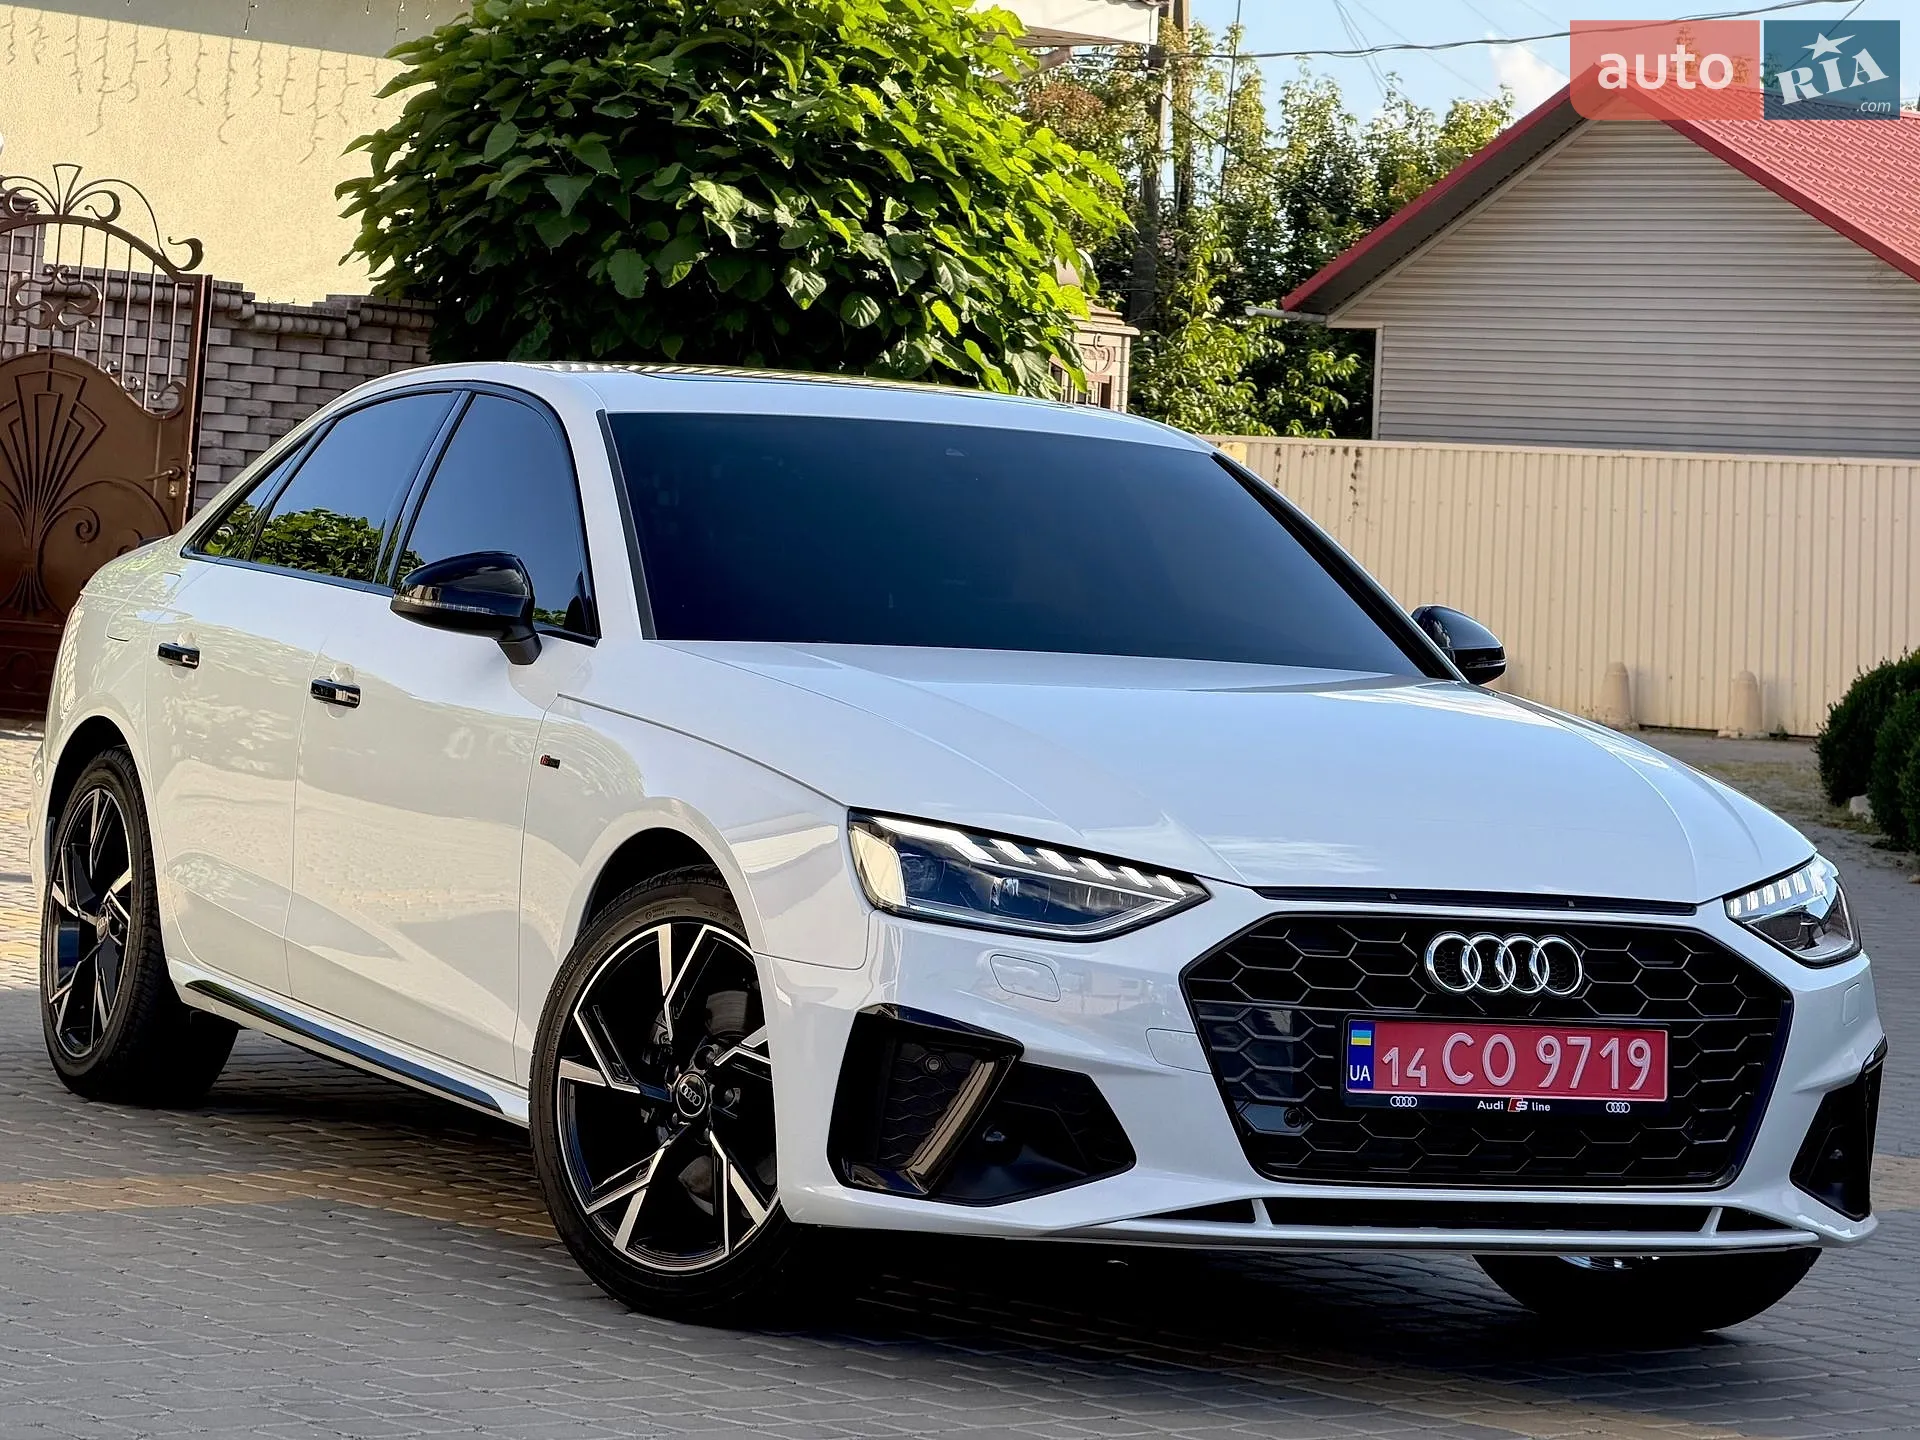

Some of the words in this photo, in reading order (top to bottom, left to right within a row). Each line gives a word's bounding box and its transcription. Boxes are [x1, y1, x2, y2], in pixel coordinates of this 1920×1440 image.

[1382, 1046, 1427, 1087] 14
[1442, 1032, 1516, 1087] CO
[1536, 1035, 1651, 1091] 9719
[1349, 1064, 1371, 1082] UA
[1476, 1100, 1504, 1110] Audi
[1531, 1101, 1551, 1112] line
